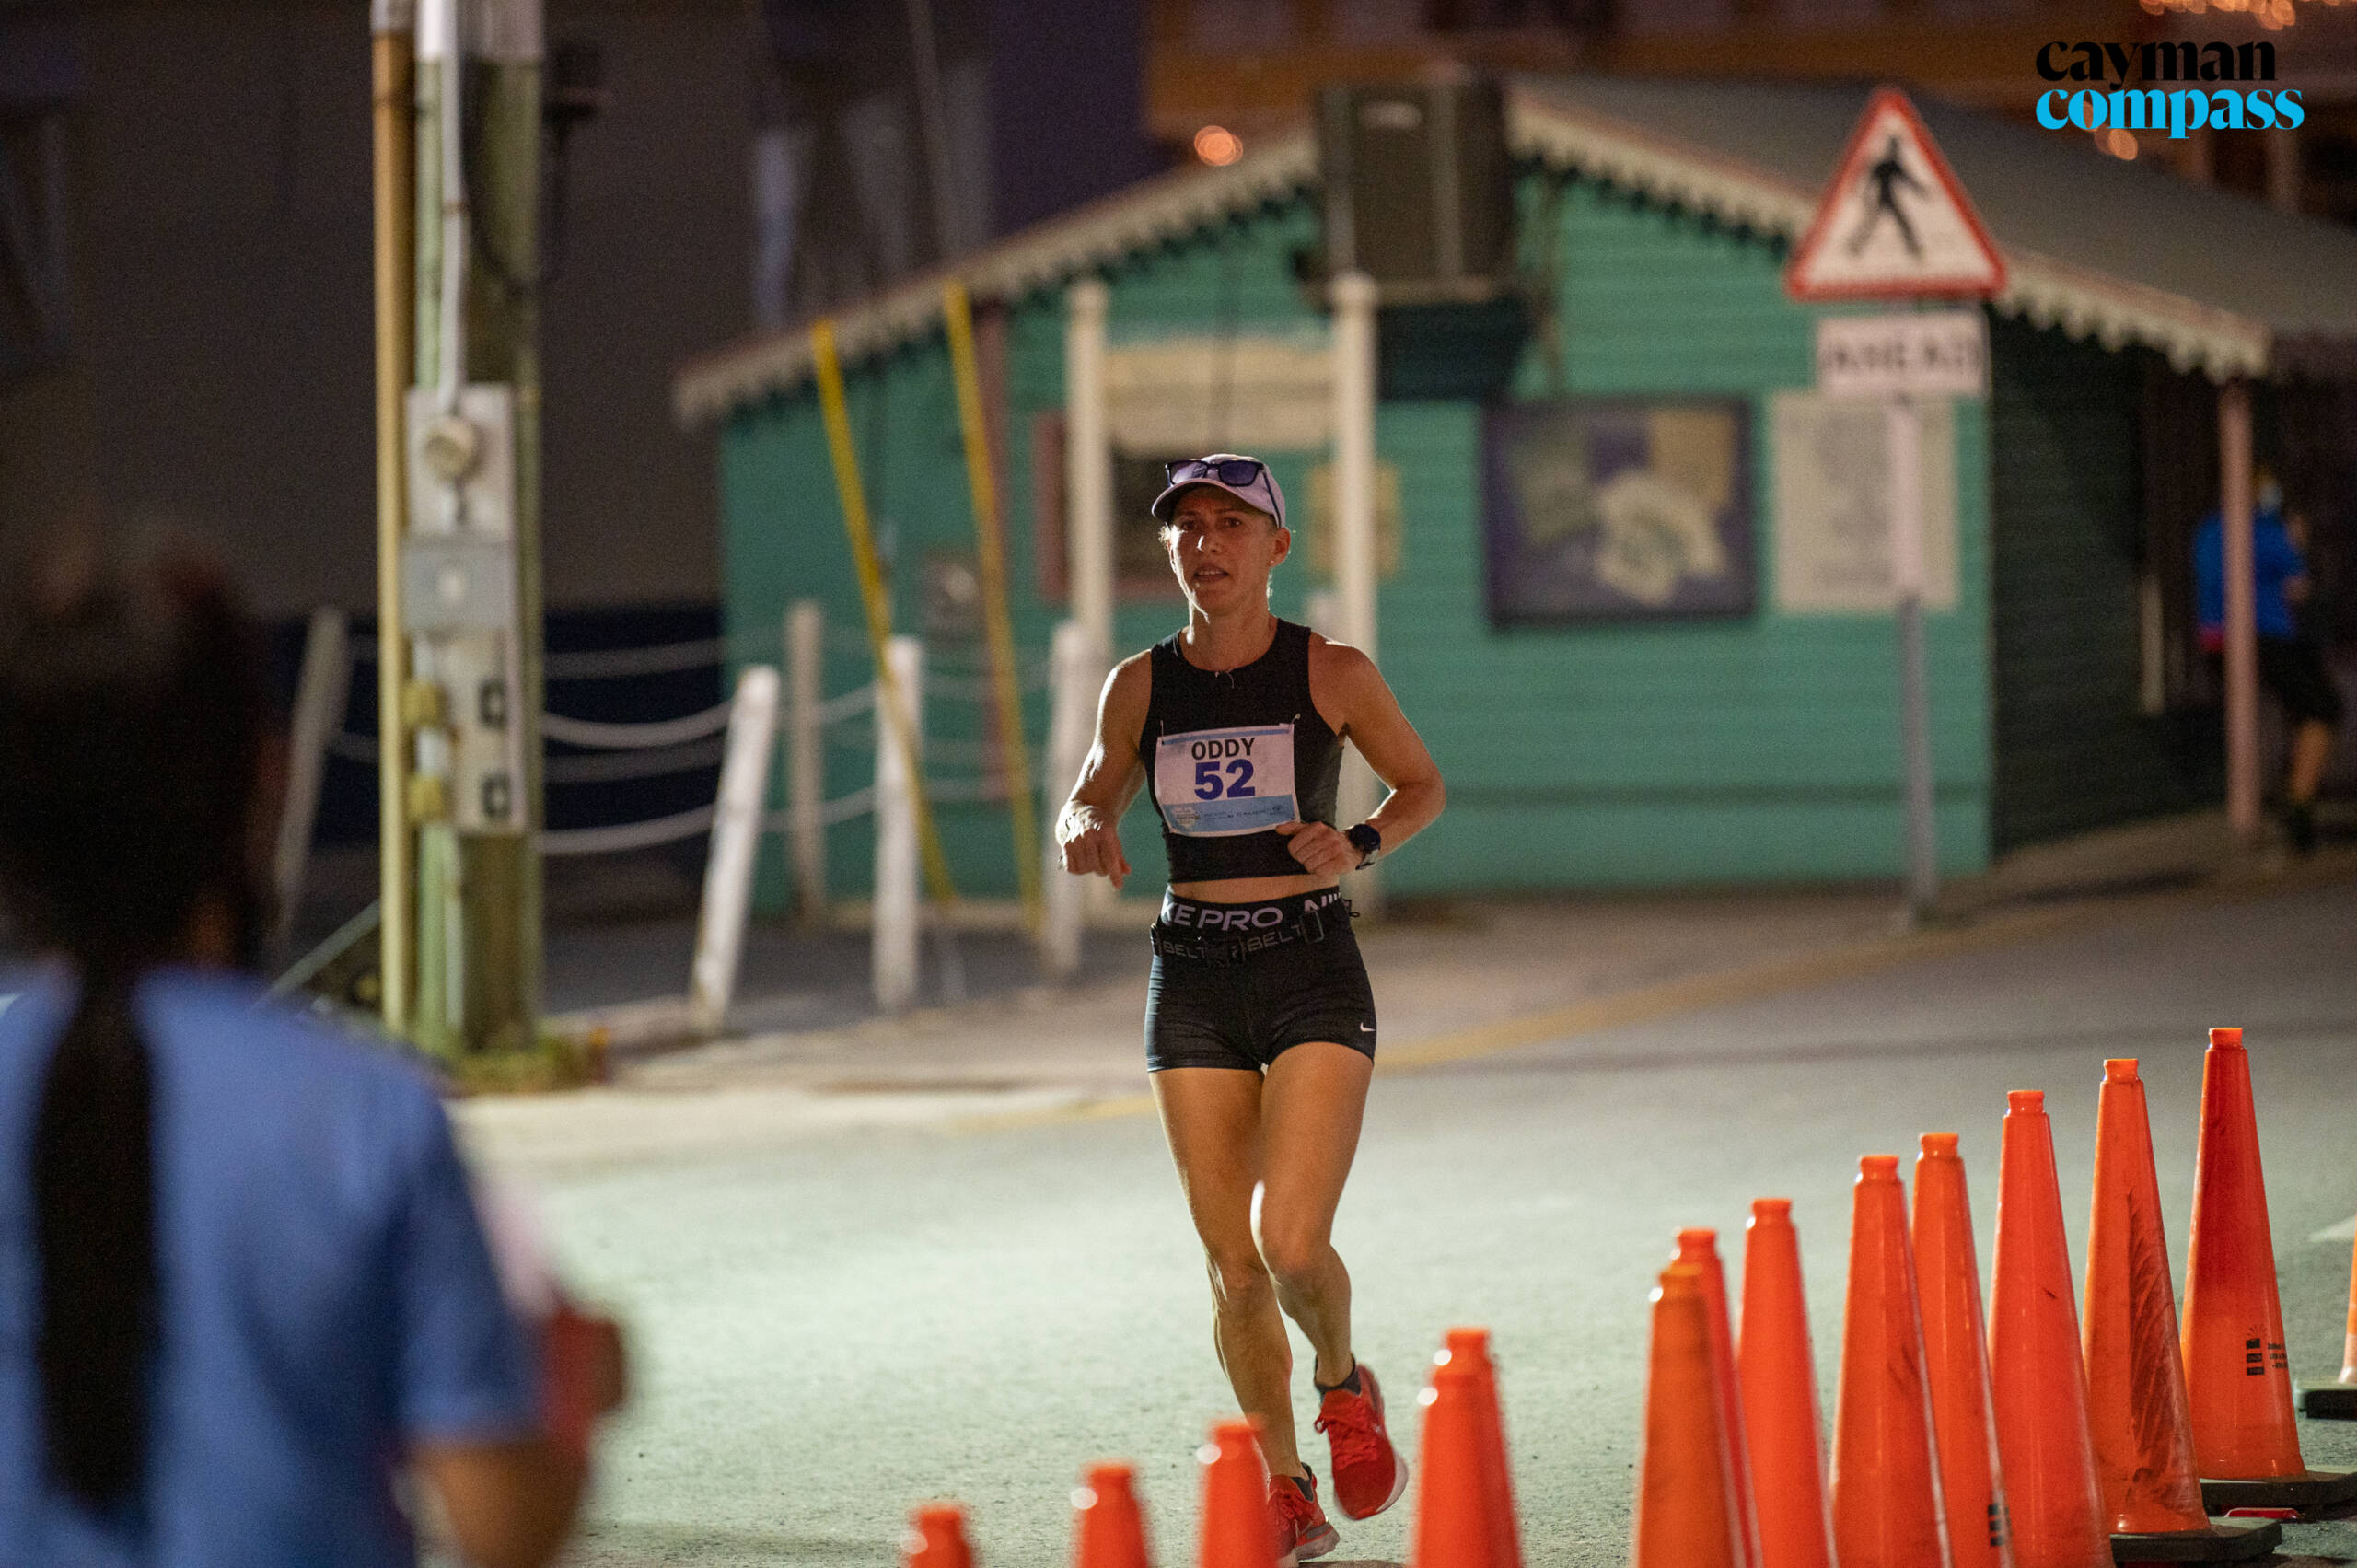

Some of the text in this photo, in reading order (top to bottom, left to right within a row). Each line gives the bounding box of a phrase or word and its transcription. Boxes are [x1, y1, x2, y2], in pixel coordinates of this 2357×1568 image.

[1820, 335, 1983, 372] AHEAD
[1191, 738, 1255, 761] ODDY
[1194, 759, 1256, 800] 52
[1197, 907, 1283, 932] PRO
[1247, 923, 1303, 952] BELT
